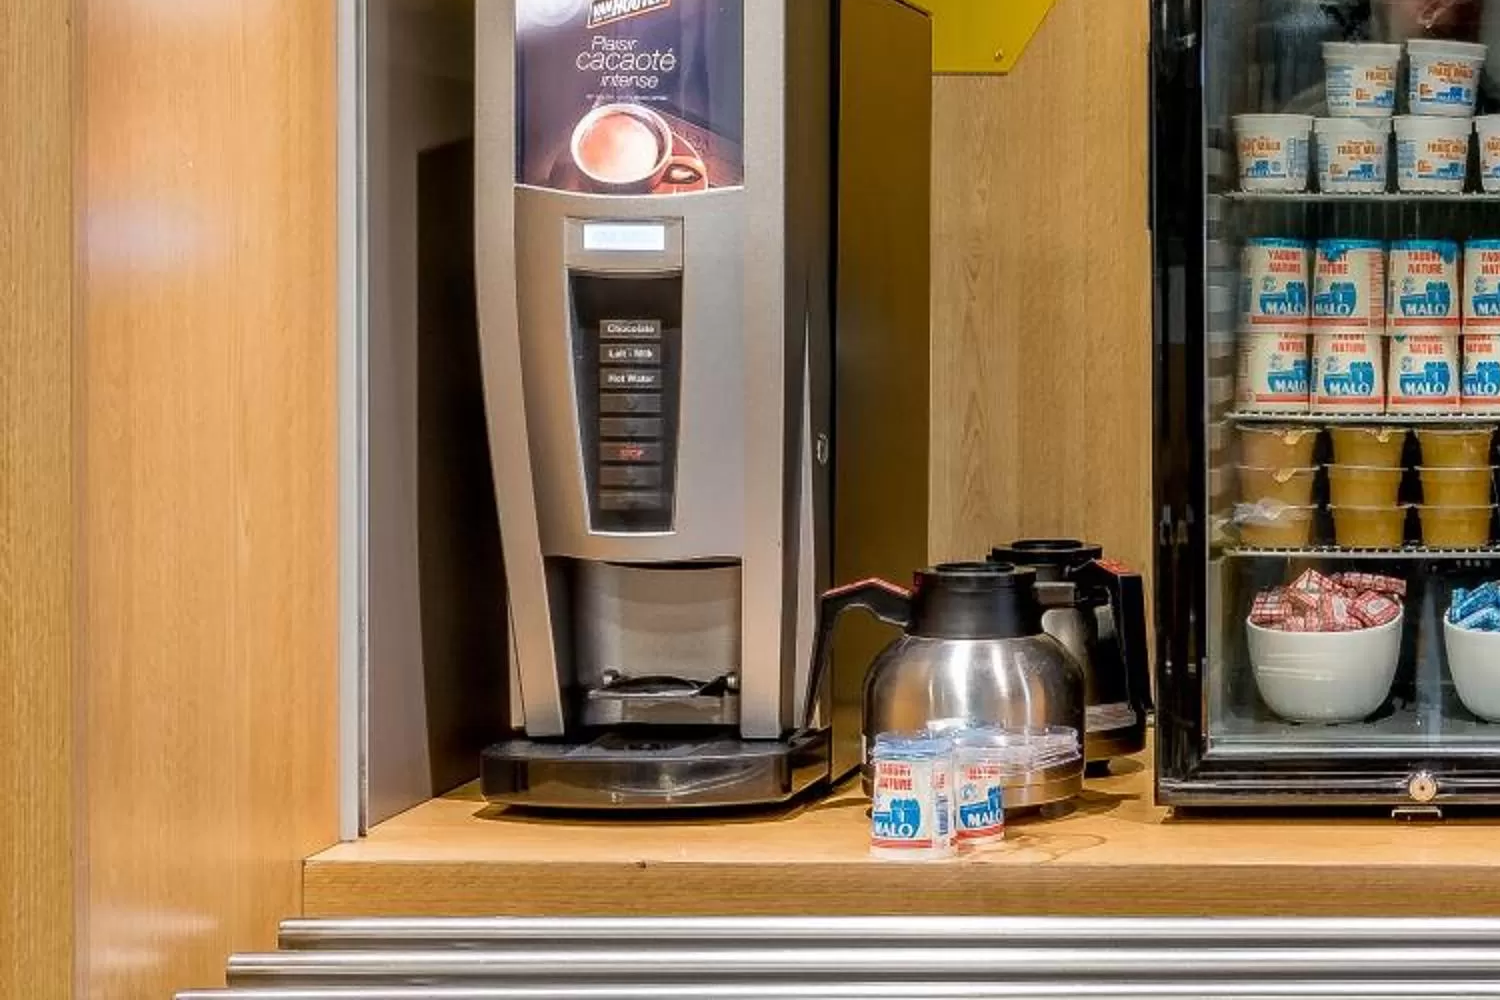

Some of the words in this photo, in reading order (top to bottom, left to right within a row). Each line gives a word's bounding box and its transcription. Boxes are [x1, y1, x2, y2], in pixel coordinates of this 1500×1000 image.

[591, 35, 638, 51] Plaisir
[575, 47, 677, 71] cacaoté
[599, 73, 659, 89] intense
[1265, 302, 1307, 315] MALO
[1405, 303, 1447, 316] MALO
[1328, 381, 1371, 395] MALO
[1404, 381, 1446, 396] MALO
[967, 808, 1004, 828] MALO
